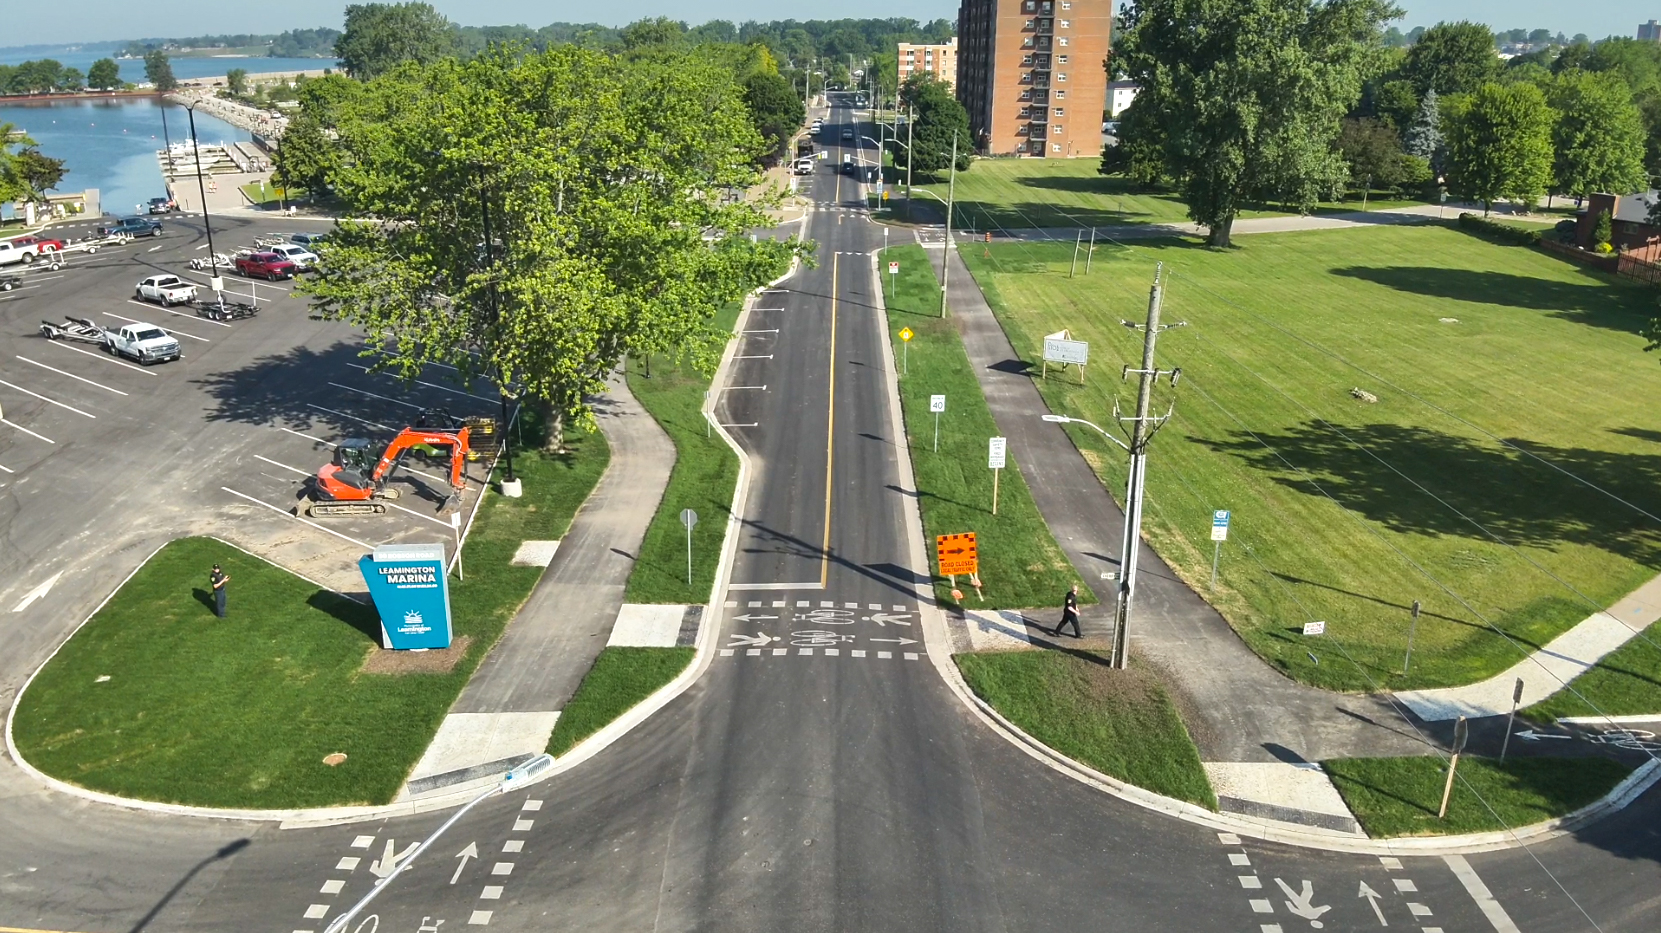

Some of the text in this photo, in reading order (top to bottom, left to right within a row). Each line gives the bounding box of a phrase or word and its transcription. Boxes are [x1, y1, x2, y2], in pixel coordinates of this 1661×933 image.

[932, 401, 943, 410] 40
[378, 566, 436, 575] LEAMINGTON
[387, 574, 436, 583] MARINA
